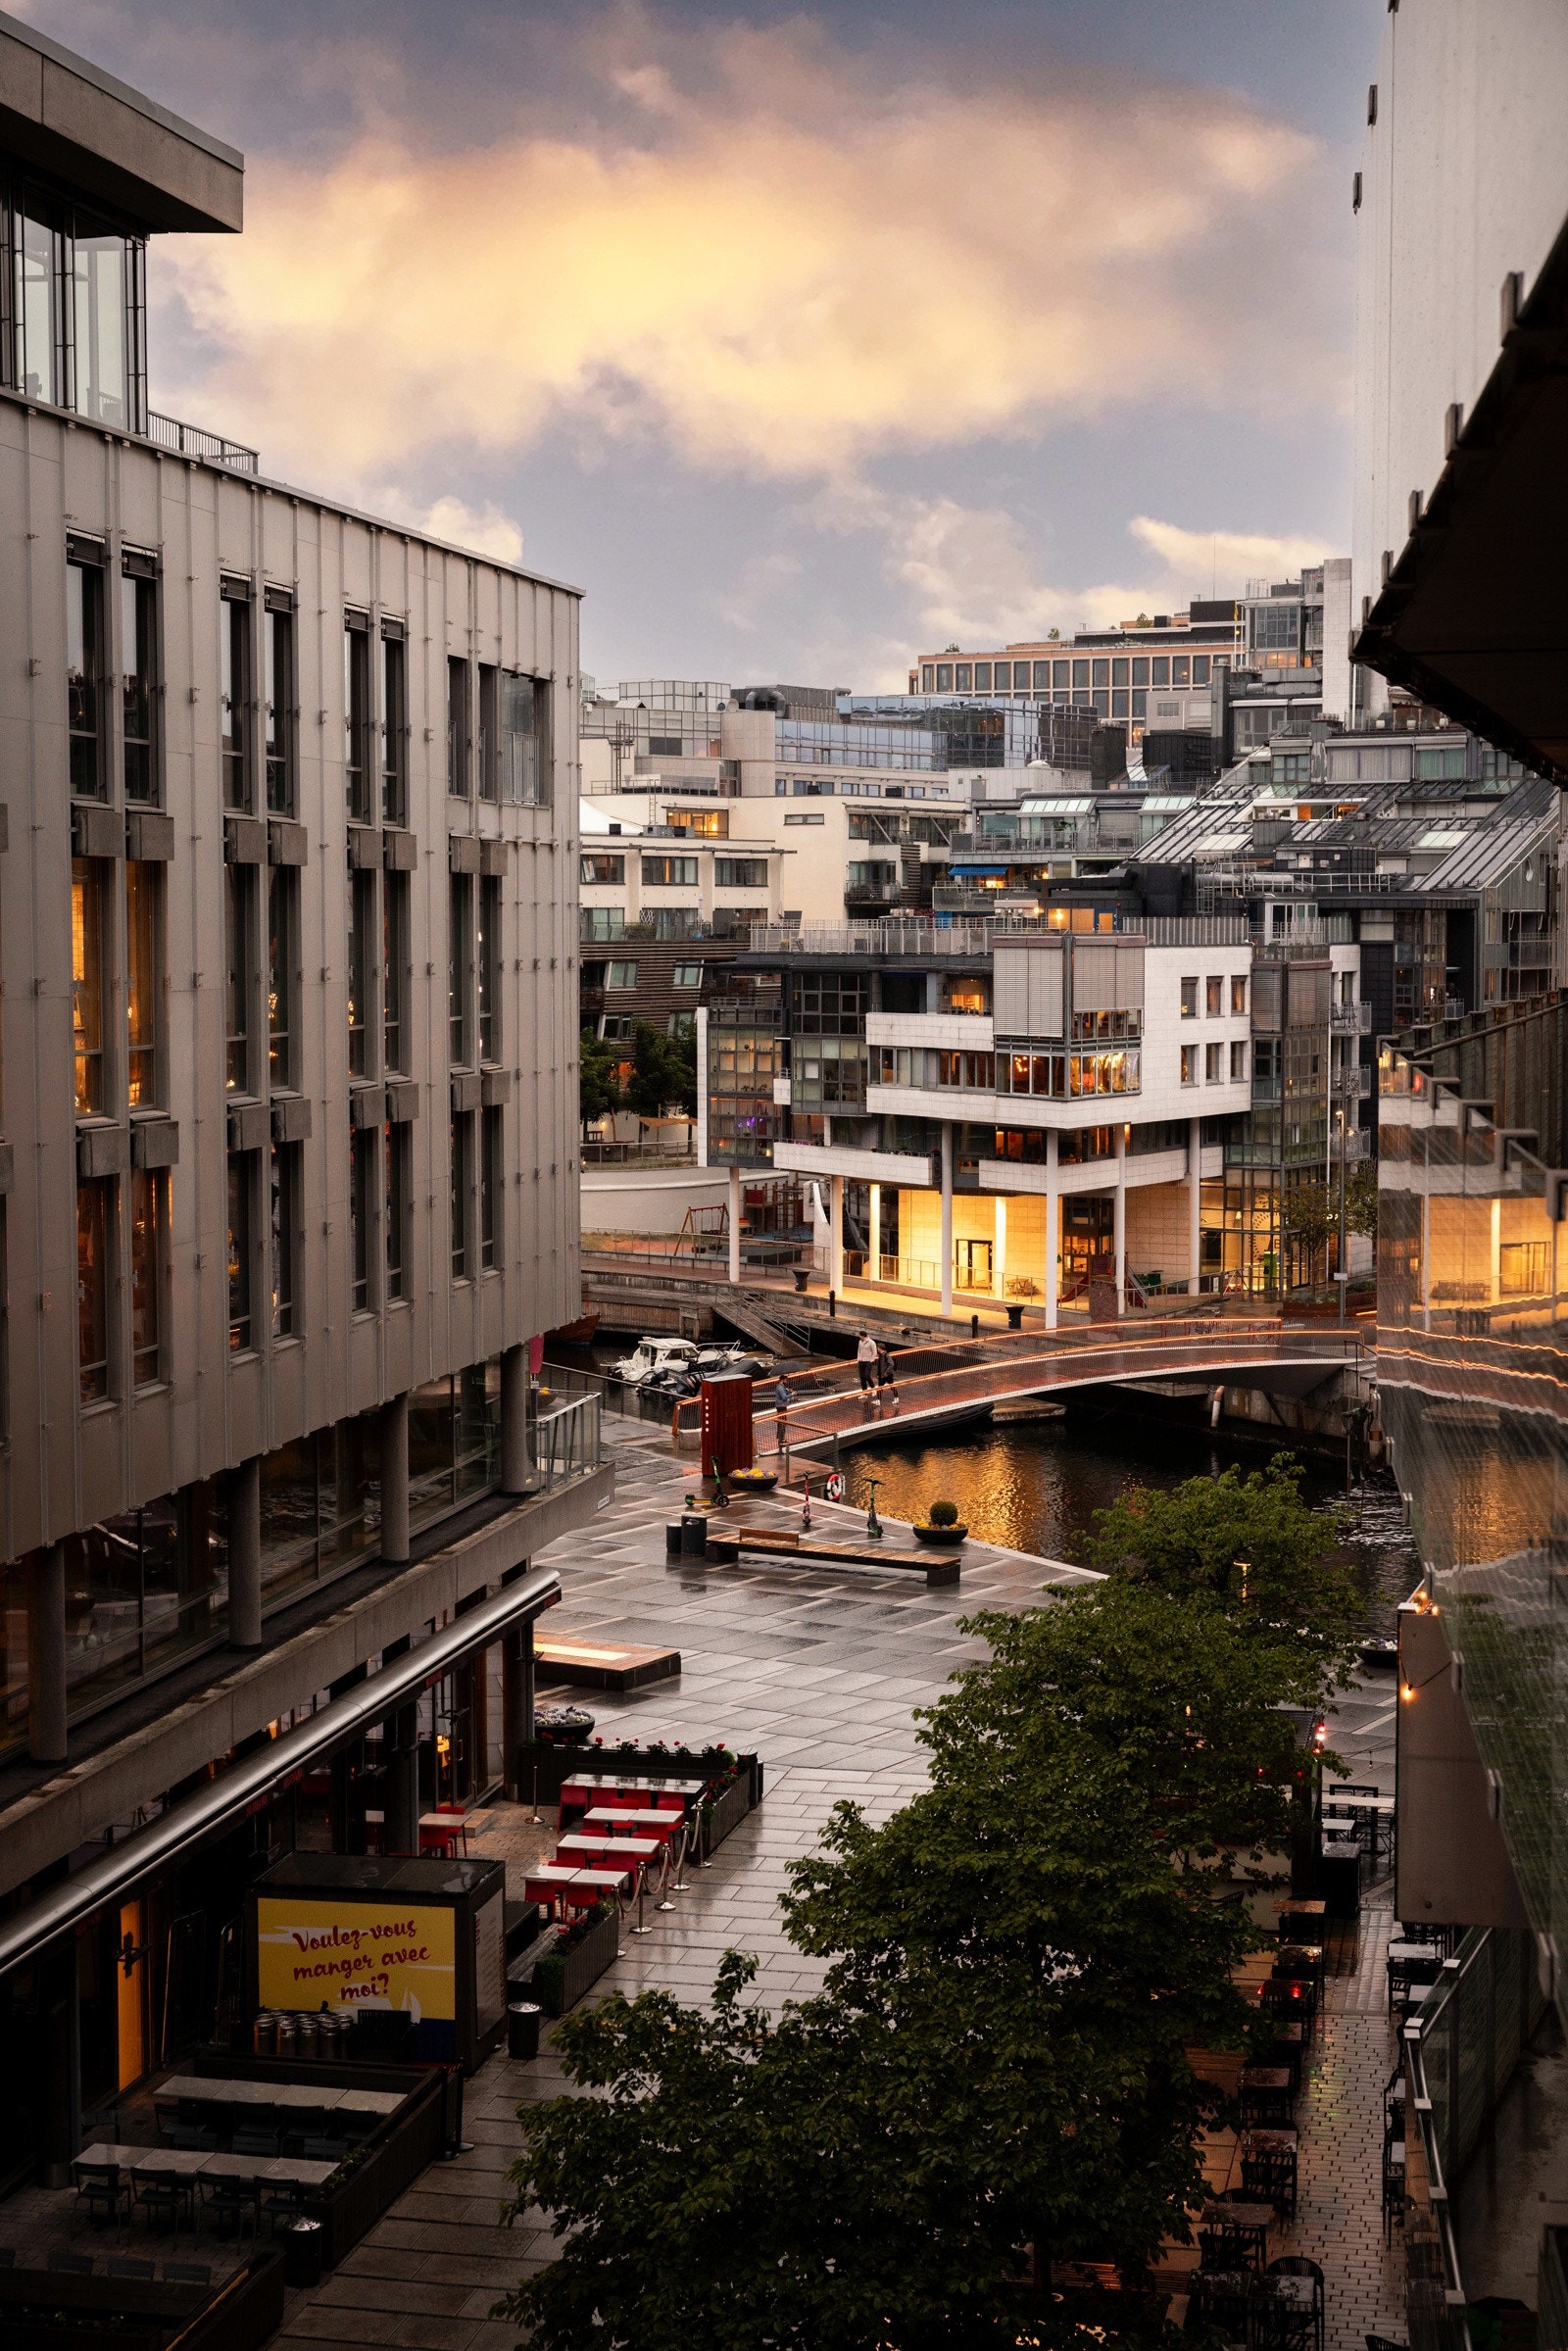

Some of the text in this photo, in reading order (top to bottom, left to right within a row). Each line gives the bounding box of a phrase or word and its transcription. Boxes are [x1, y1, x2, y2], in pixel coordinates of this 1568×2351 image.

[292, 1920, 417, 1952] Voulez-vous
[293, 1946, 430, 1981] manger avec
[340, 1973, 389, 2000] moi?
